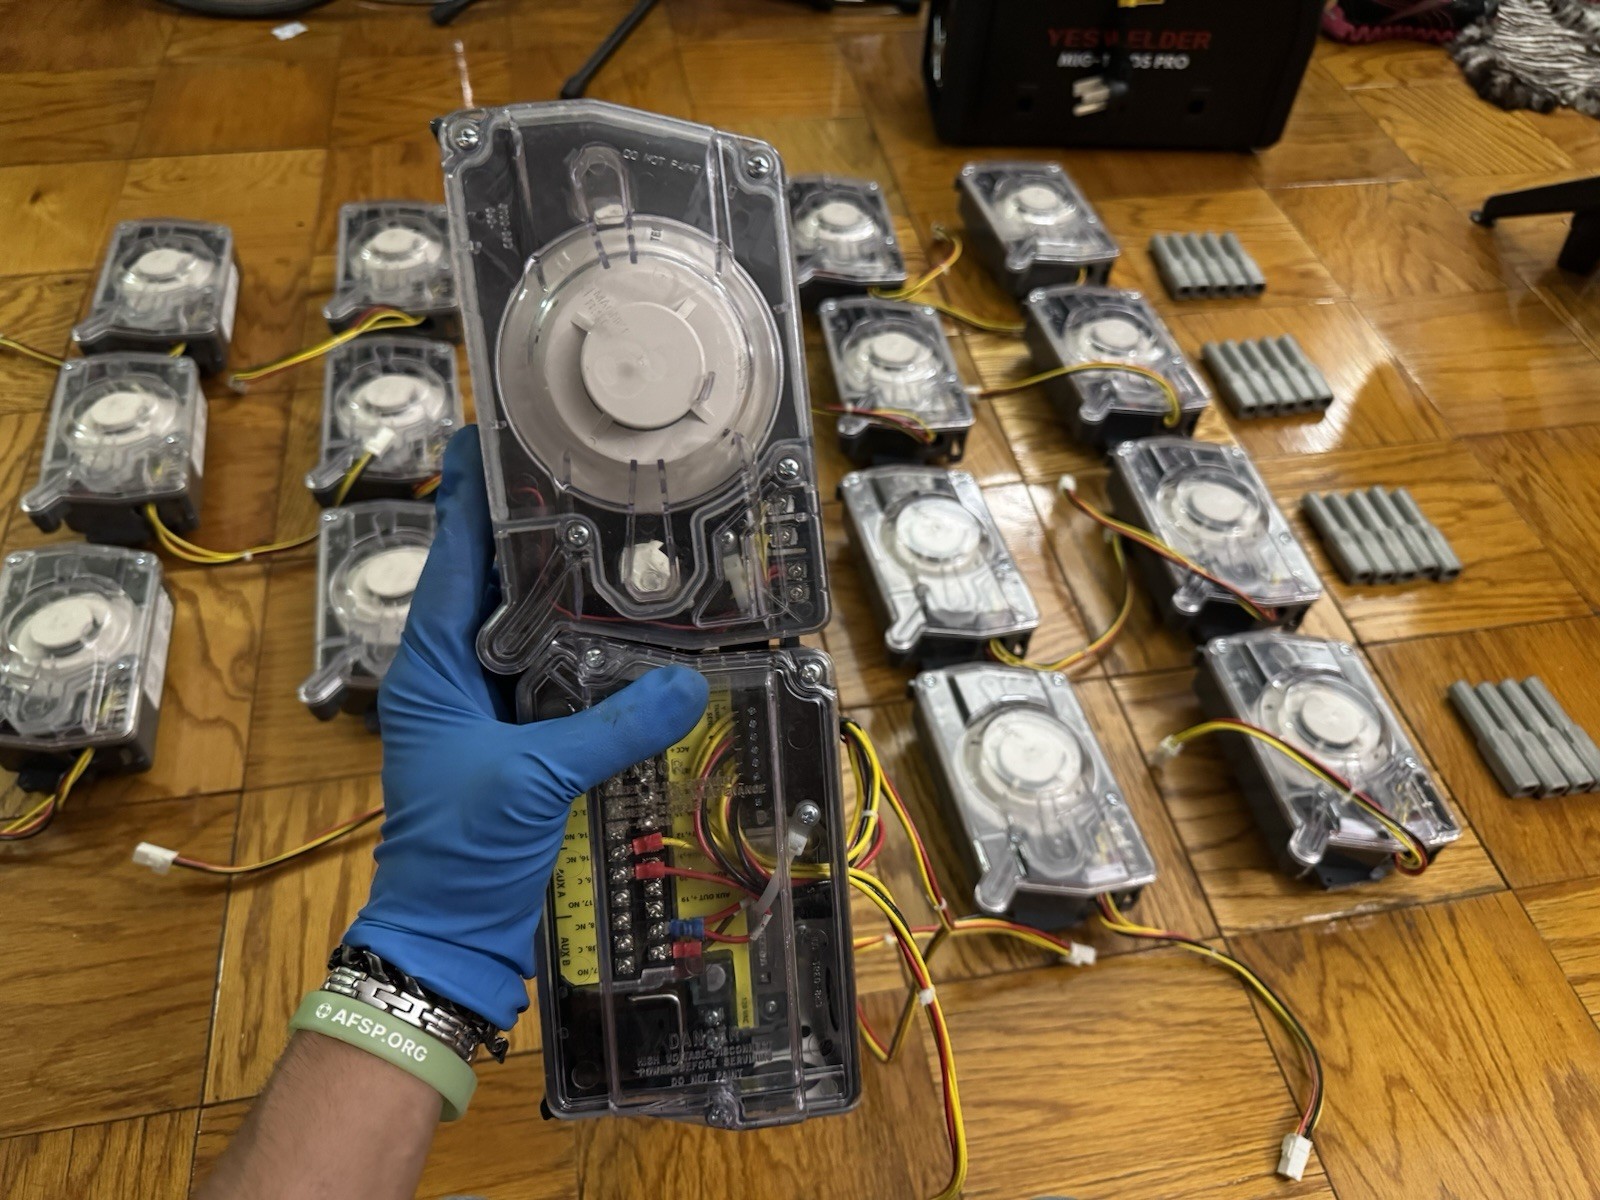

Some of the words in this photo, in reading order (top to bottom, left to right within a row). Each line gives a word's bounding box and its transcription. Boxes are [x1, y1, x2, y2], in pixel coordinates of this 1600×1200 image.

[1153, 52, 1191, 70] PRO
[561, 937, 570, 957] AUX
[331, 1008, 428, 1062] AFSP.ORG
[671, 1076, 685, 1087] DO
[691, 1072, 709, 1084] NOT
